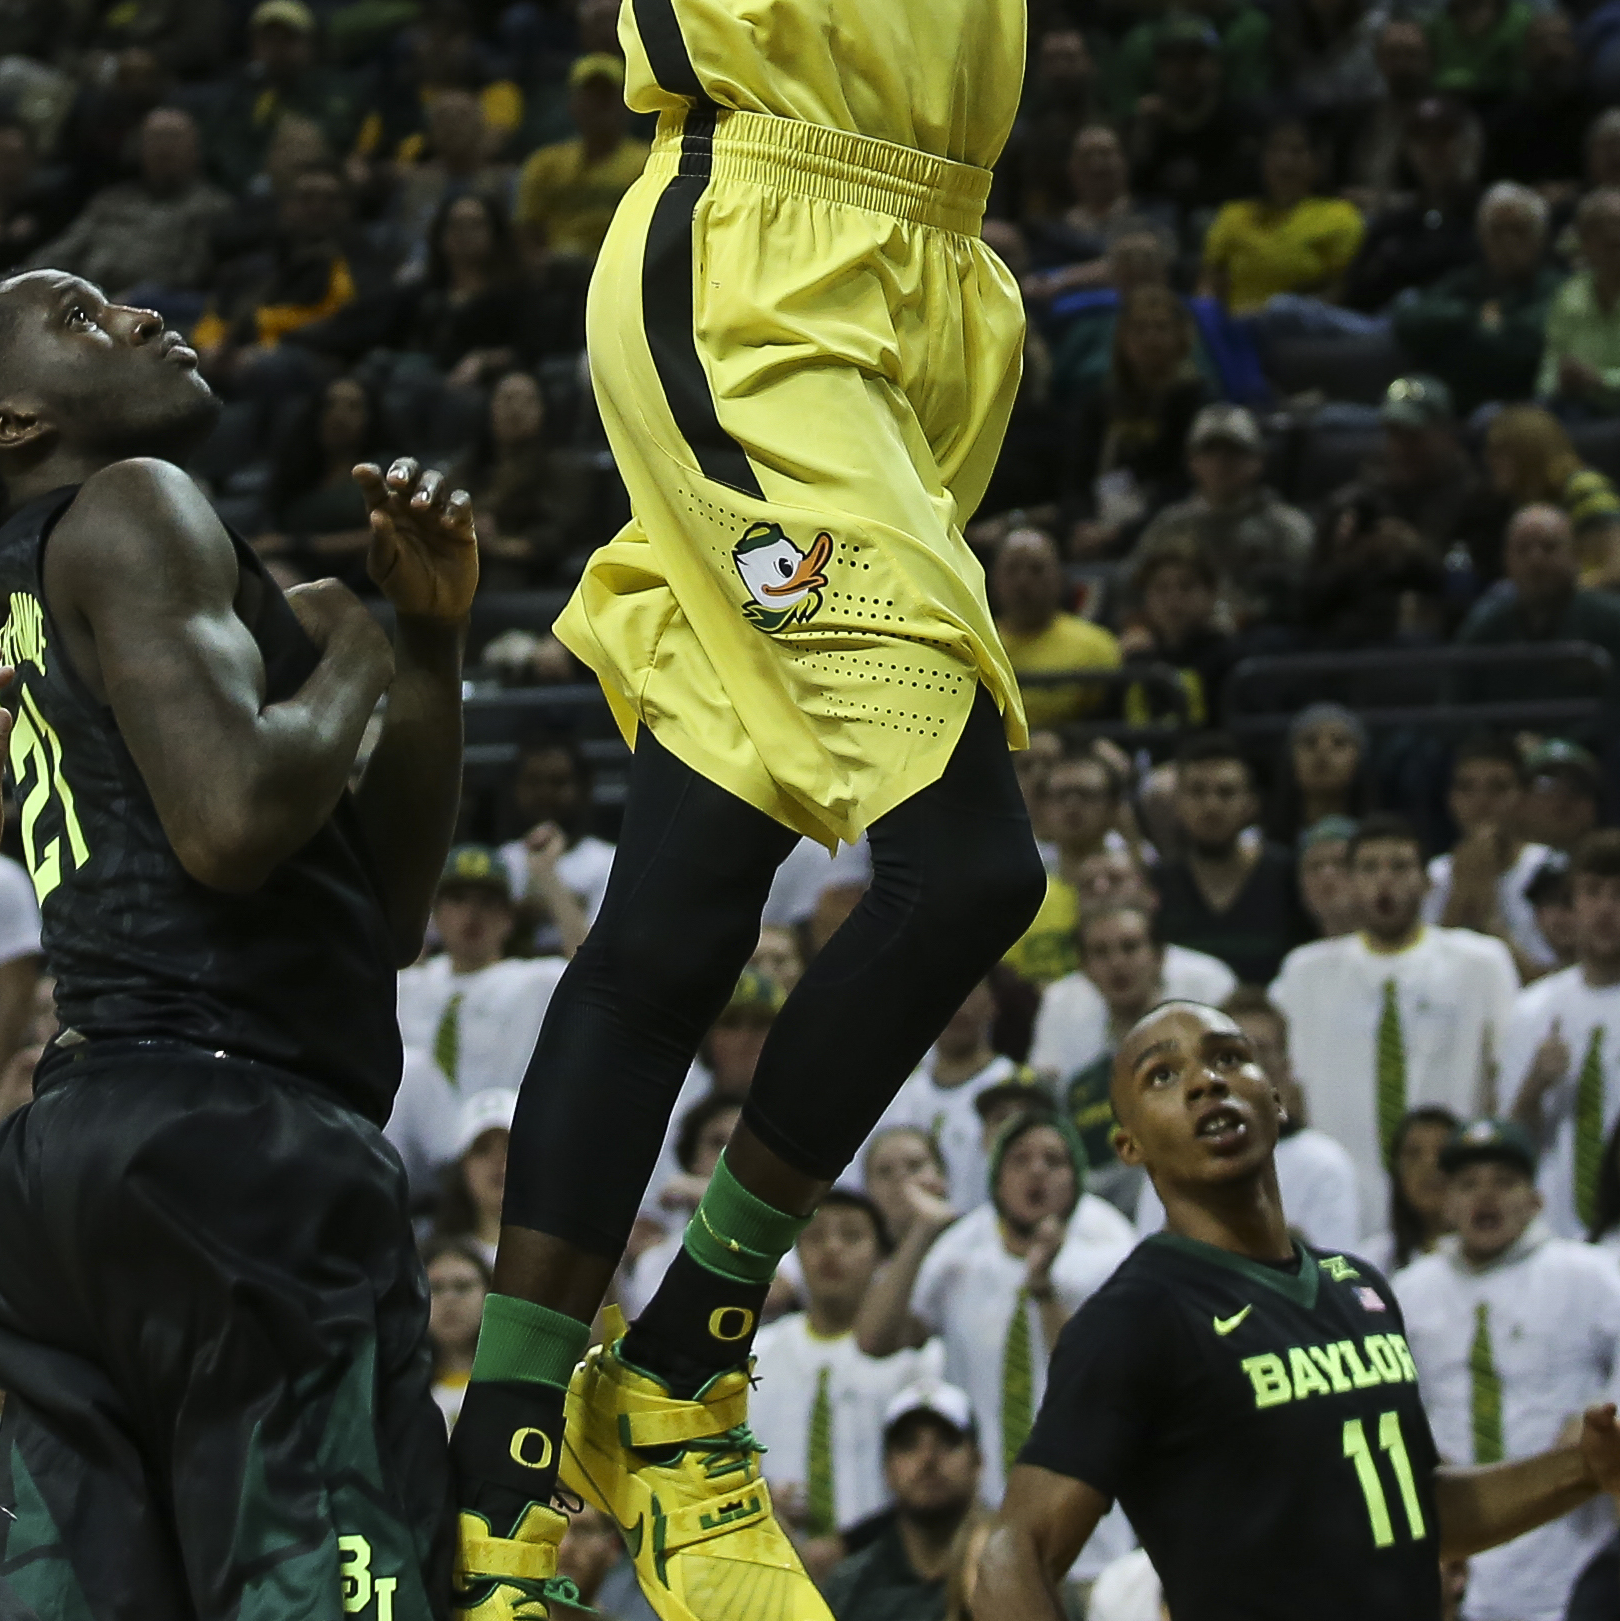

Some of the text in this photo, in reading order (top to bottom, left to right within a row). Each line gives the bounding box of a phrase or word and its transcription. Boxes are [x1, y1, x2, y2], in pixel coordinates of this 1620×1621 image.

[9, 682, 90, 909] 21
[1240, 1331, 1420, 1410] BAYLOR
[1342, 1410, 1427, 1549] 11
